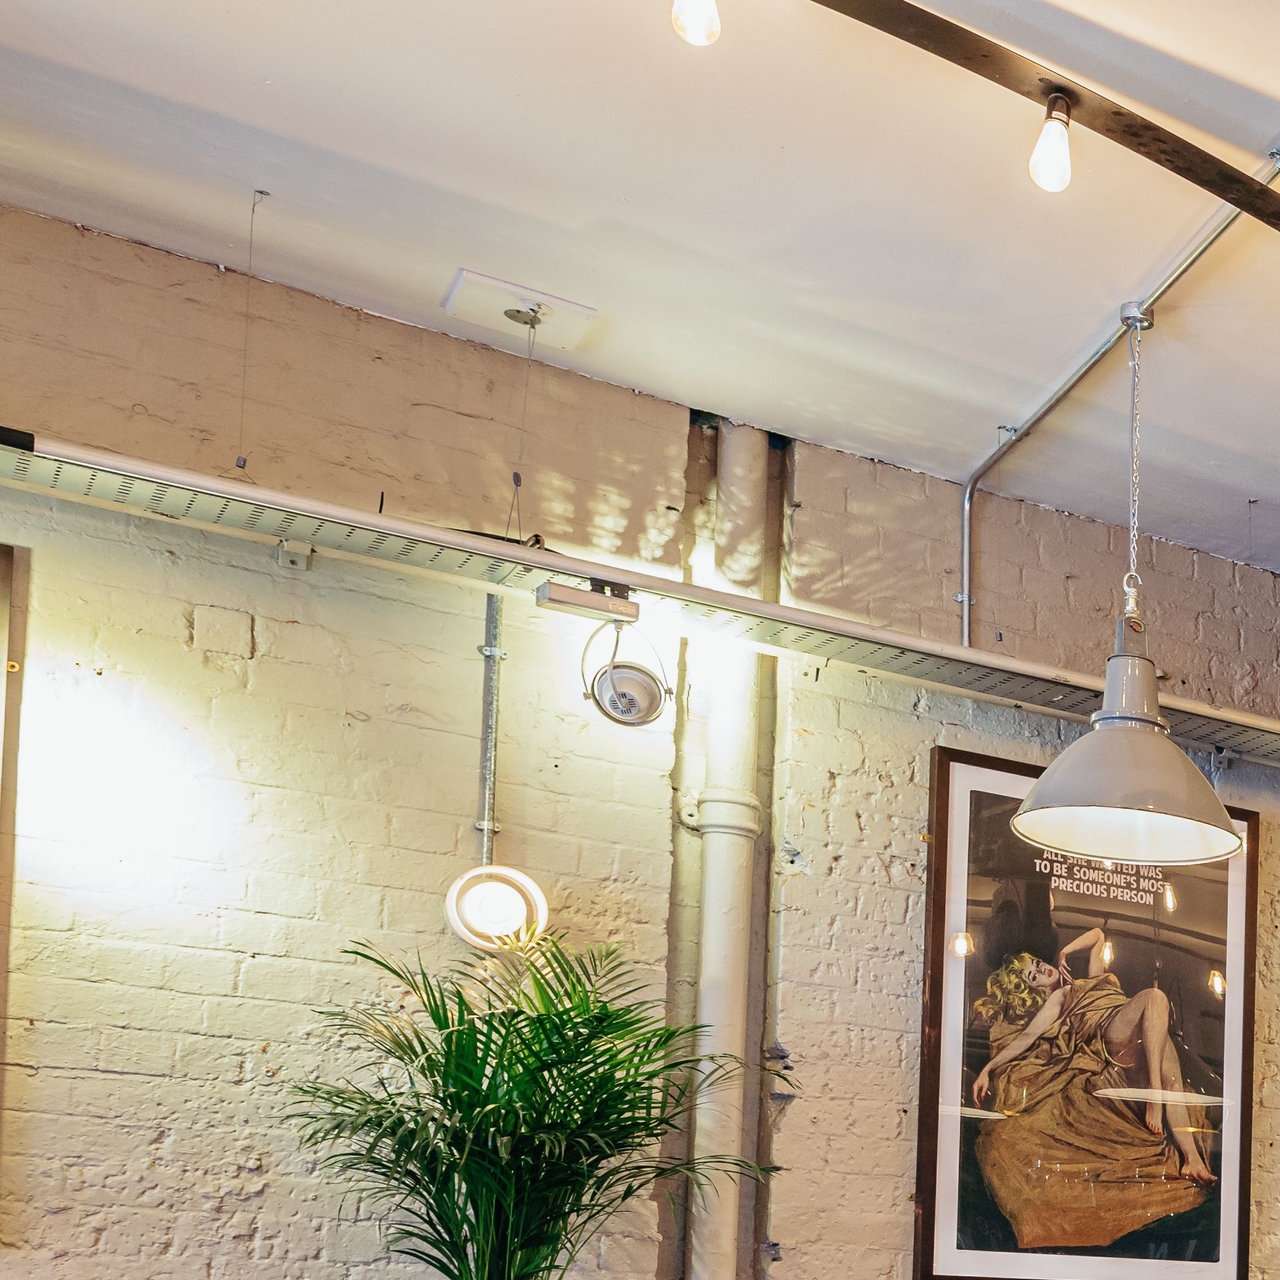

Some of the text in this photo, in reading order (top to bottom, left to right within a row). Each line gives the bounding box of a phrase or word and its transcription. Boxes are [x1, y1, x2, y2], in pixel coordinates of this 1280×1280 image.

[1034, 859, 1050, 874] TO
[1053, 862, 1068, 877] BE
[1073, 866, 1137, 889] SOMEONE'S
[1043, 850, 1163, 879] ALL SHE WTED WAS
[1051, 877, 1154, 905] PRECIOUS PERSON
